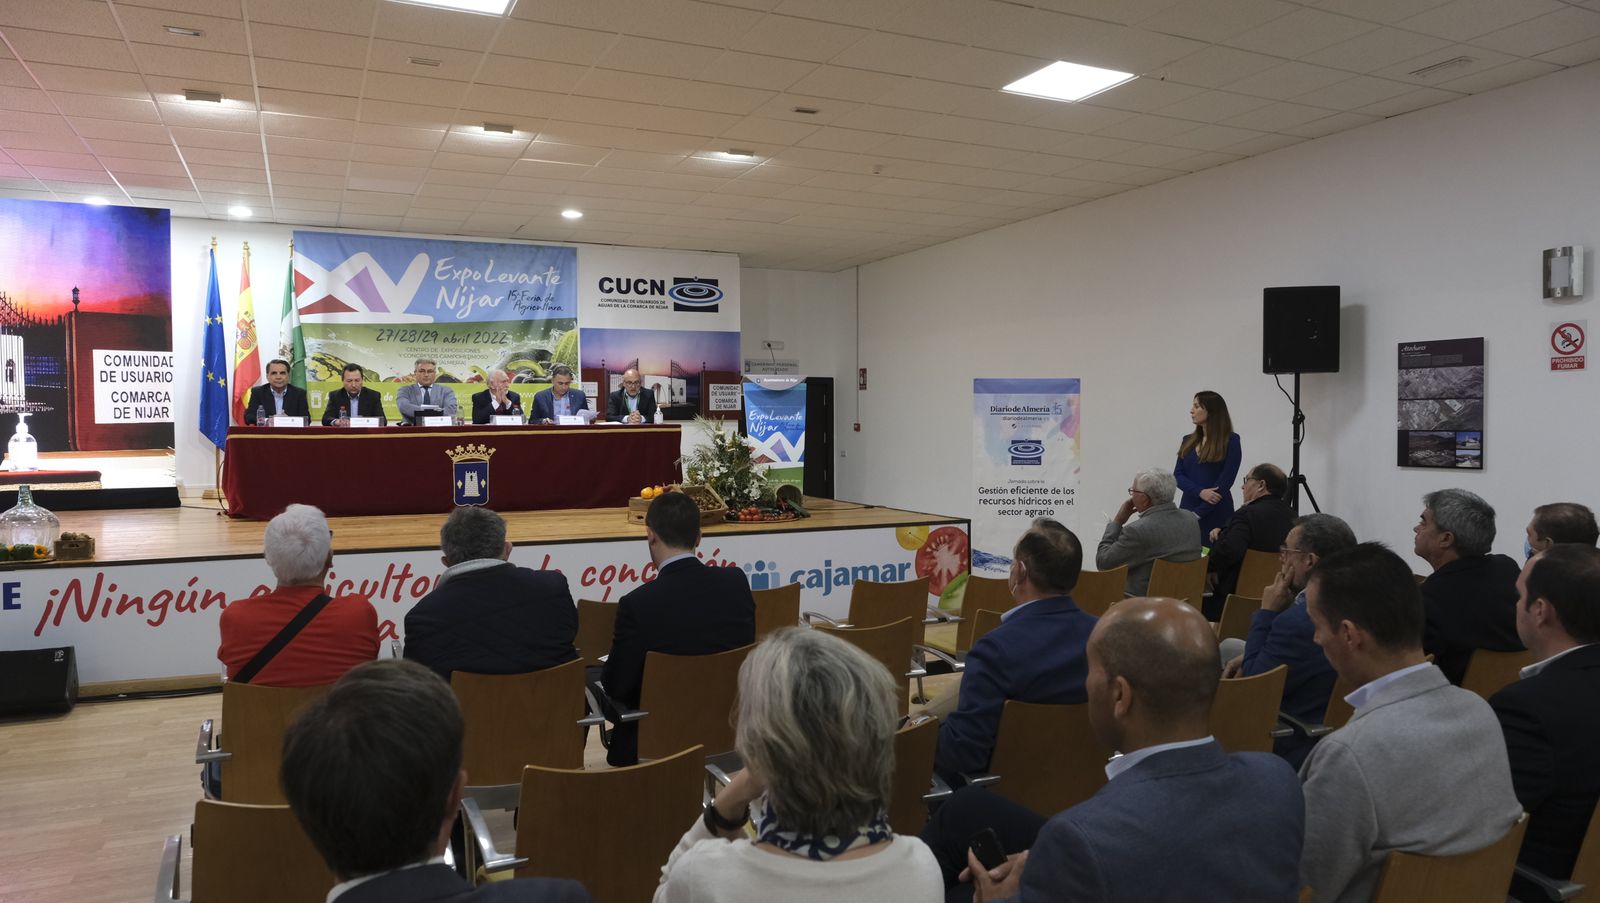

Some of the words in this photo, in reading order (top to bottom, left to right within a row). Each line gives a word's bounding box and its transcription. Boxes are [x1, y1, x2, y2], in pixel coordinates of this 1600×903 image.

[598, 277, 665, 296] CUCN
[436, 286, 504, 319] Níjar
[520, 290, 543, 302] Feria
[544, 293, 555, 302] de
[376, 328, 439, 344] 27/28/29
[442, 332, 471, 344] abril
[472, 331, 508, 344] 2022
[100, 371, 117, 382] DE
[111, 391, 171, 403] COMARCA
[383, 392, 393, 401] de
[113, 407, 131, 419] DE
[135, 406, 169, 418] NIJAR
[978, 486, 1008, 495] Gestión
[1010, 485, 1048, 495] eficiente
[1050, 487, 1061, 495] de
[1063, 487, 1075, 495] los
[1018, 496, 1052, 505] hídricos
[998, 508, 1023, 516] sector
[1024, 508, 1055, 518] agrario
[789, 559, 911, 596] cajamar
[33, 572, 227, 637] ¡Ningún
